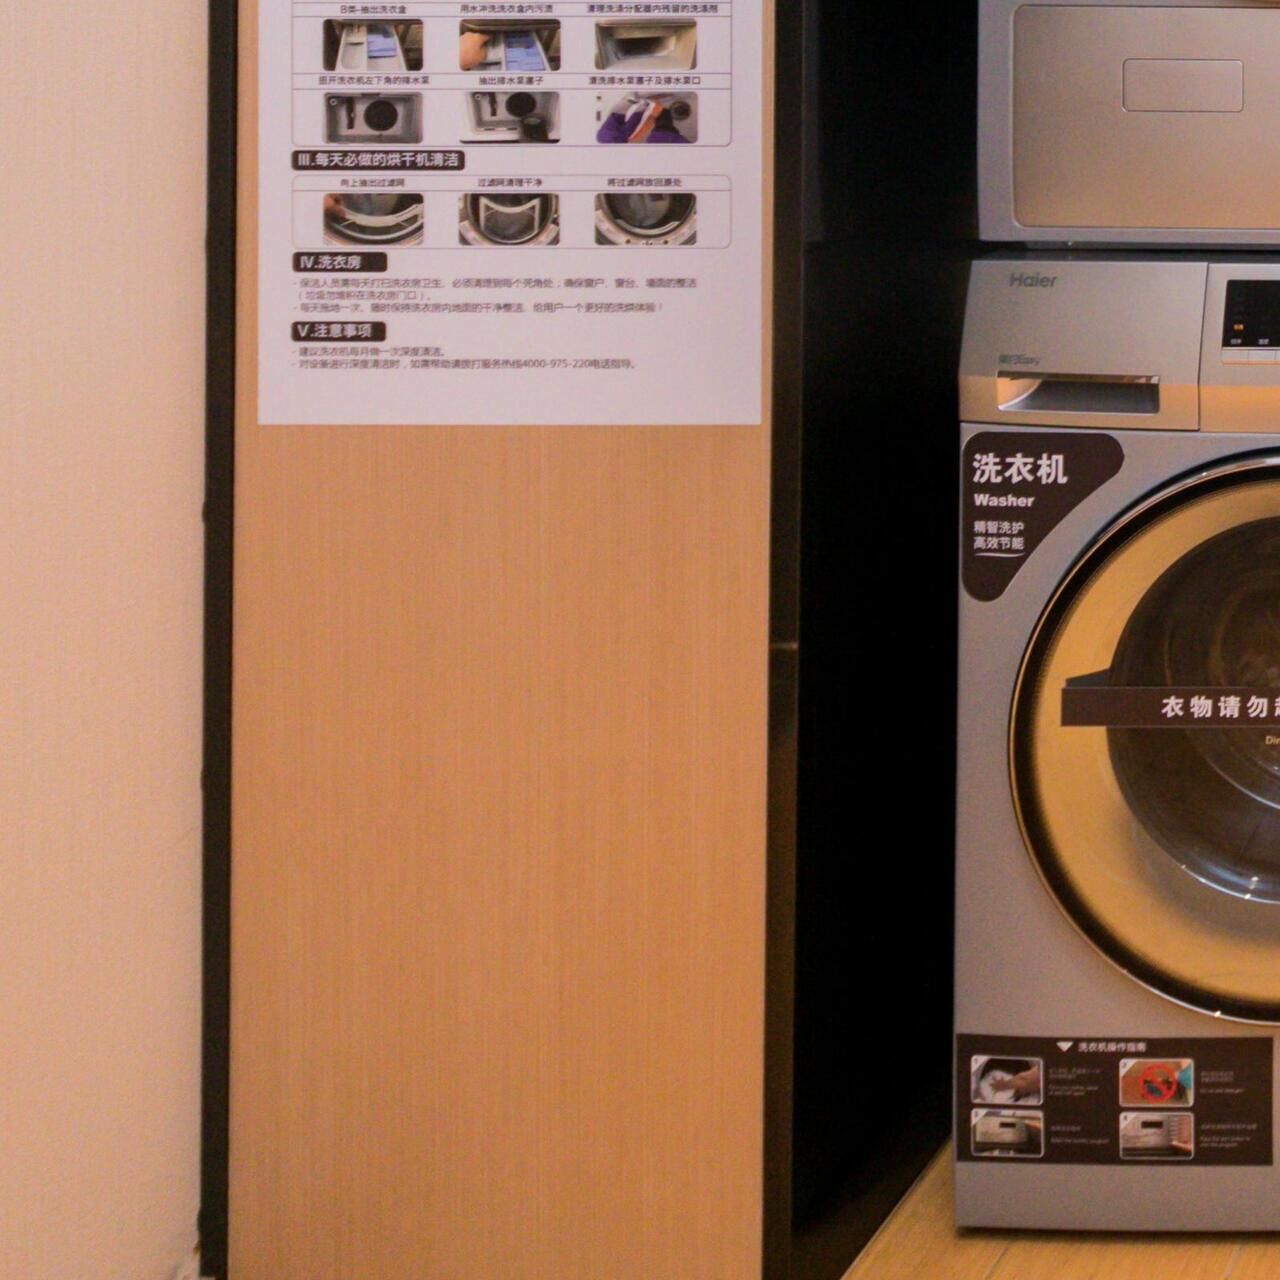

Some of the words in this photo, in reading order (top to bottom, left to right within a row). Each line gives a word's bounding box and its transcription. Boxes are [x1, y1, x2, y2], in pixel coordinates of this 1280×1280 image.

[1008, 272, 1057, 288] Haier
[972, 452, 1068, 484] 洗衣机
[974, 494, 1035, 507] Washer
[974, 521, 1024, 534] 精智洗护
[974, 536, 1024, 550] 高效节能
